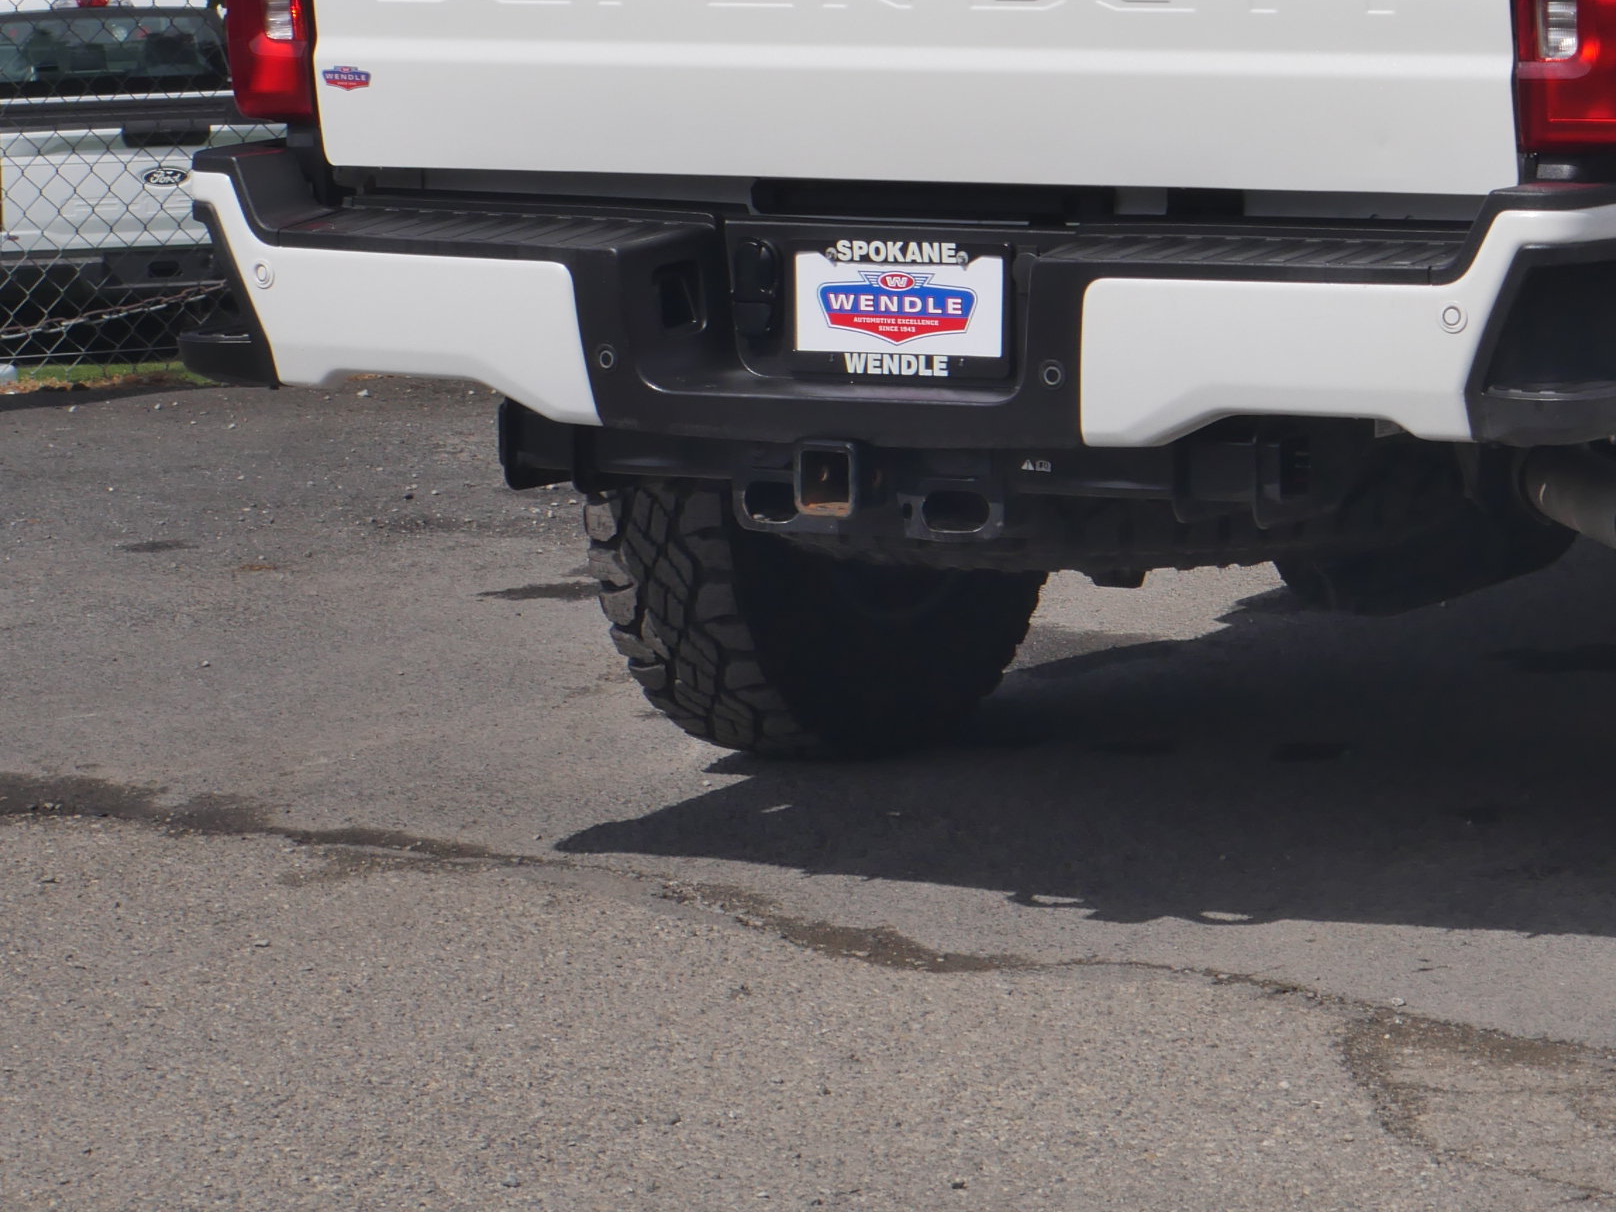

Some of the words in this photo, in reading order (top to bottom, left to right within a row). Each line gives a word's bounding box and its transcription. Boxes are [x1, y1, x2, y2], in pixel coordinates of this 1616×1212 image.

[325, 73, 367, 81] WENDLE
[836, 240, 957, 264] SPOKANE
[885, 276, 908, 287] W
[828, 292, 963, 315] WENDLE
[853, 316, 896, 325] AUTOMOTIVE
[897, 318, 939, 326] EXCELLENCE
[844, 352, 949, 377] WENDLE
